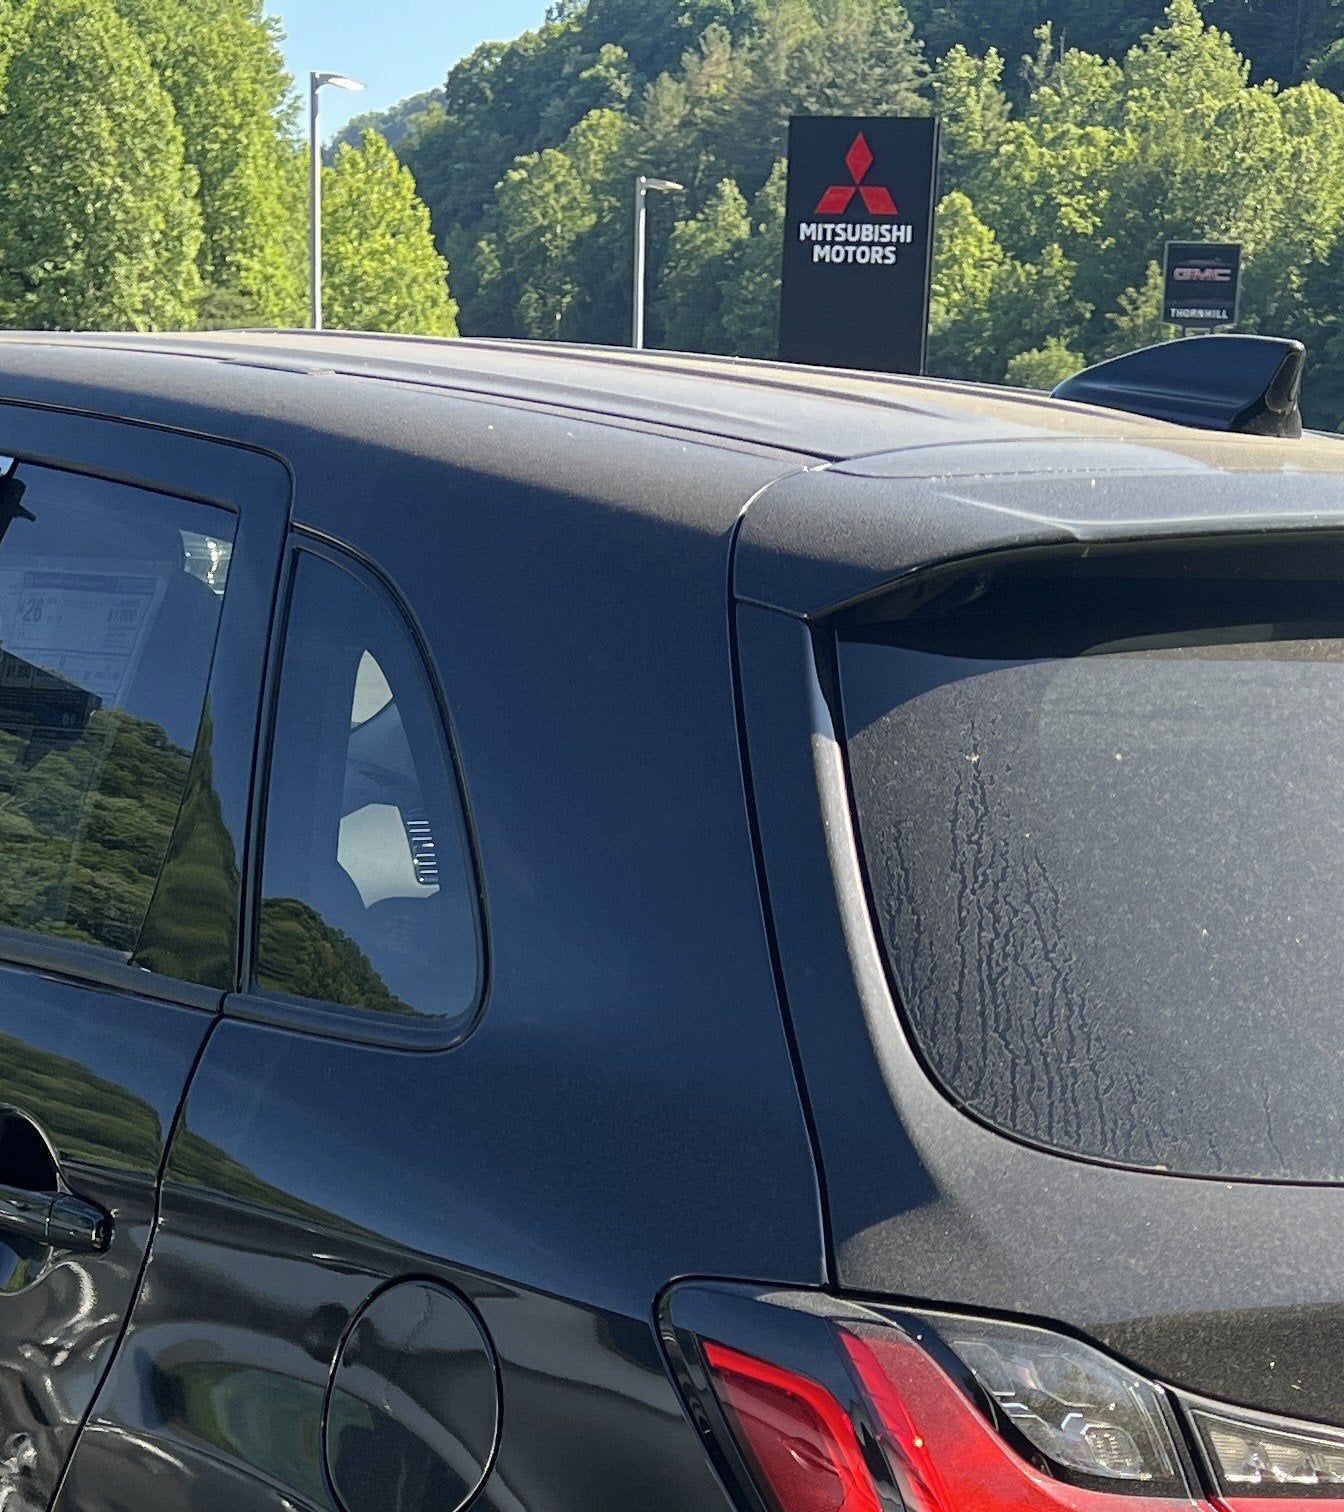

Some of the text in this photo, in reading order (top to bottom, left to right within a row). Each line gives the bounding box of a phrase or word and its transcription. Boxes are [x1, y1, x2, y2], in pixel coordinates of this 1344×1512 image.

[799, 222, 913, 243] MITSUBISHI
[812, 244, 897, 264] MOTORS
[1173, 267, 1232, 281] GMC
[1170, 307, 1228, 319] THORNHILL
